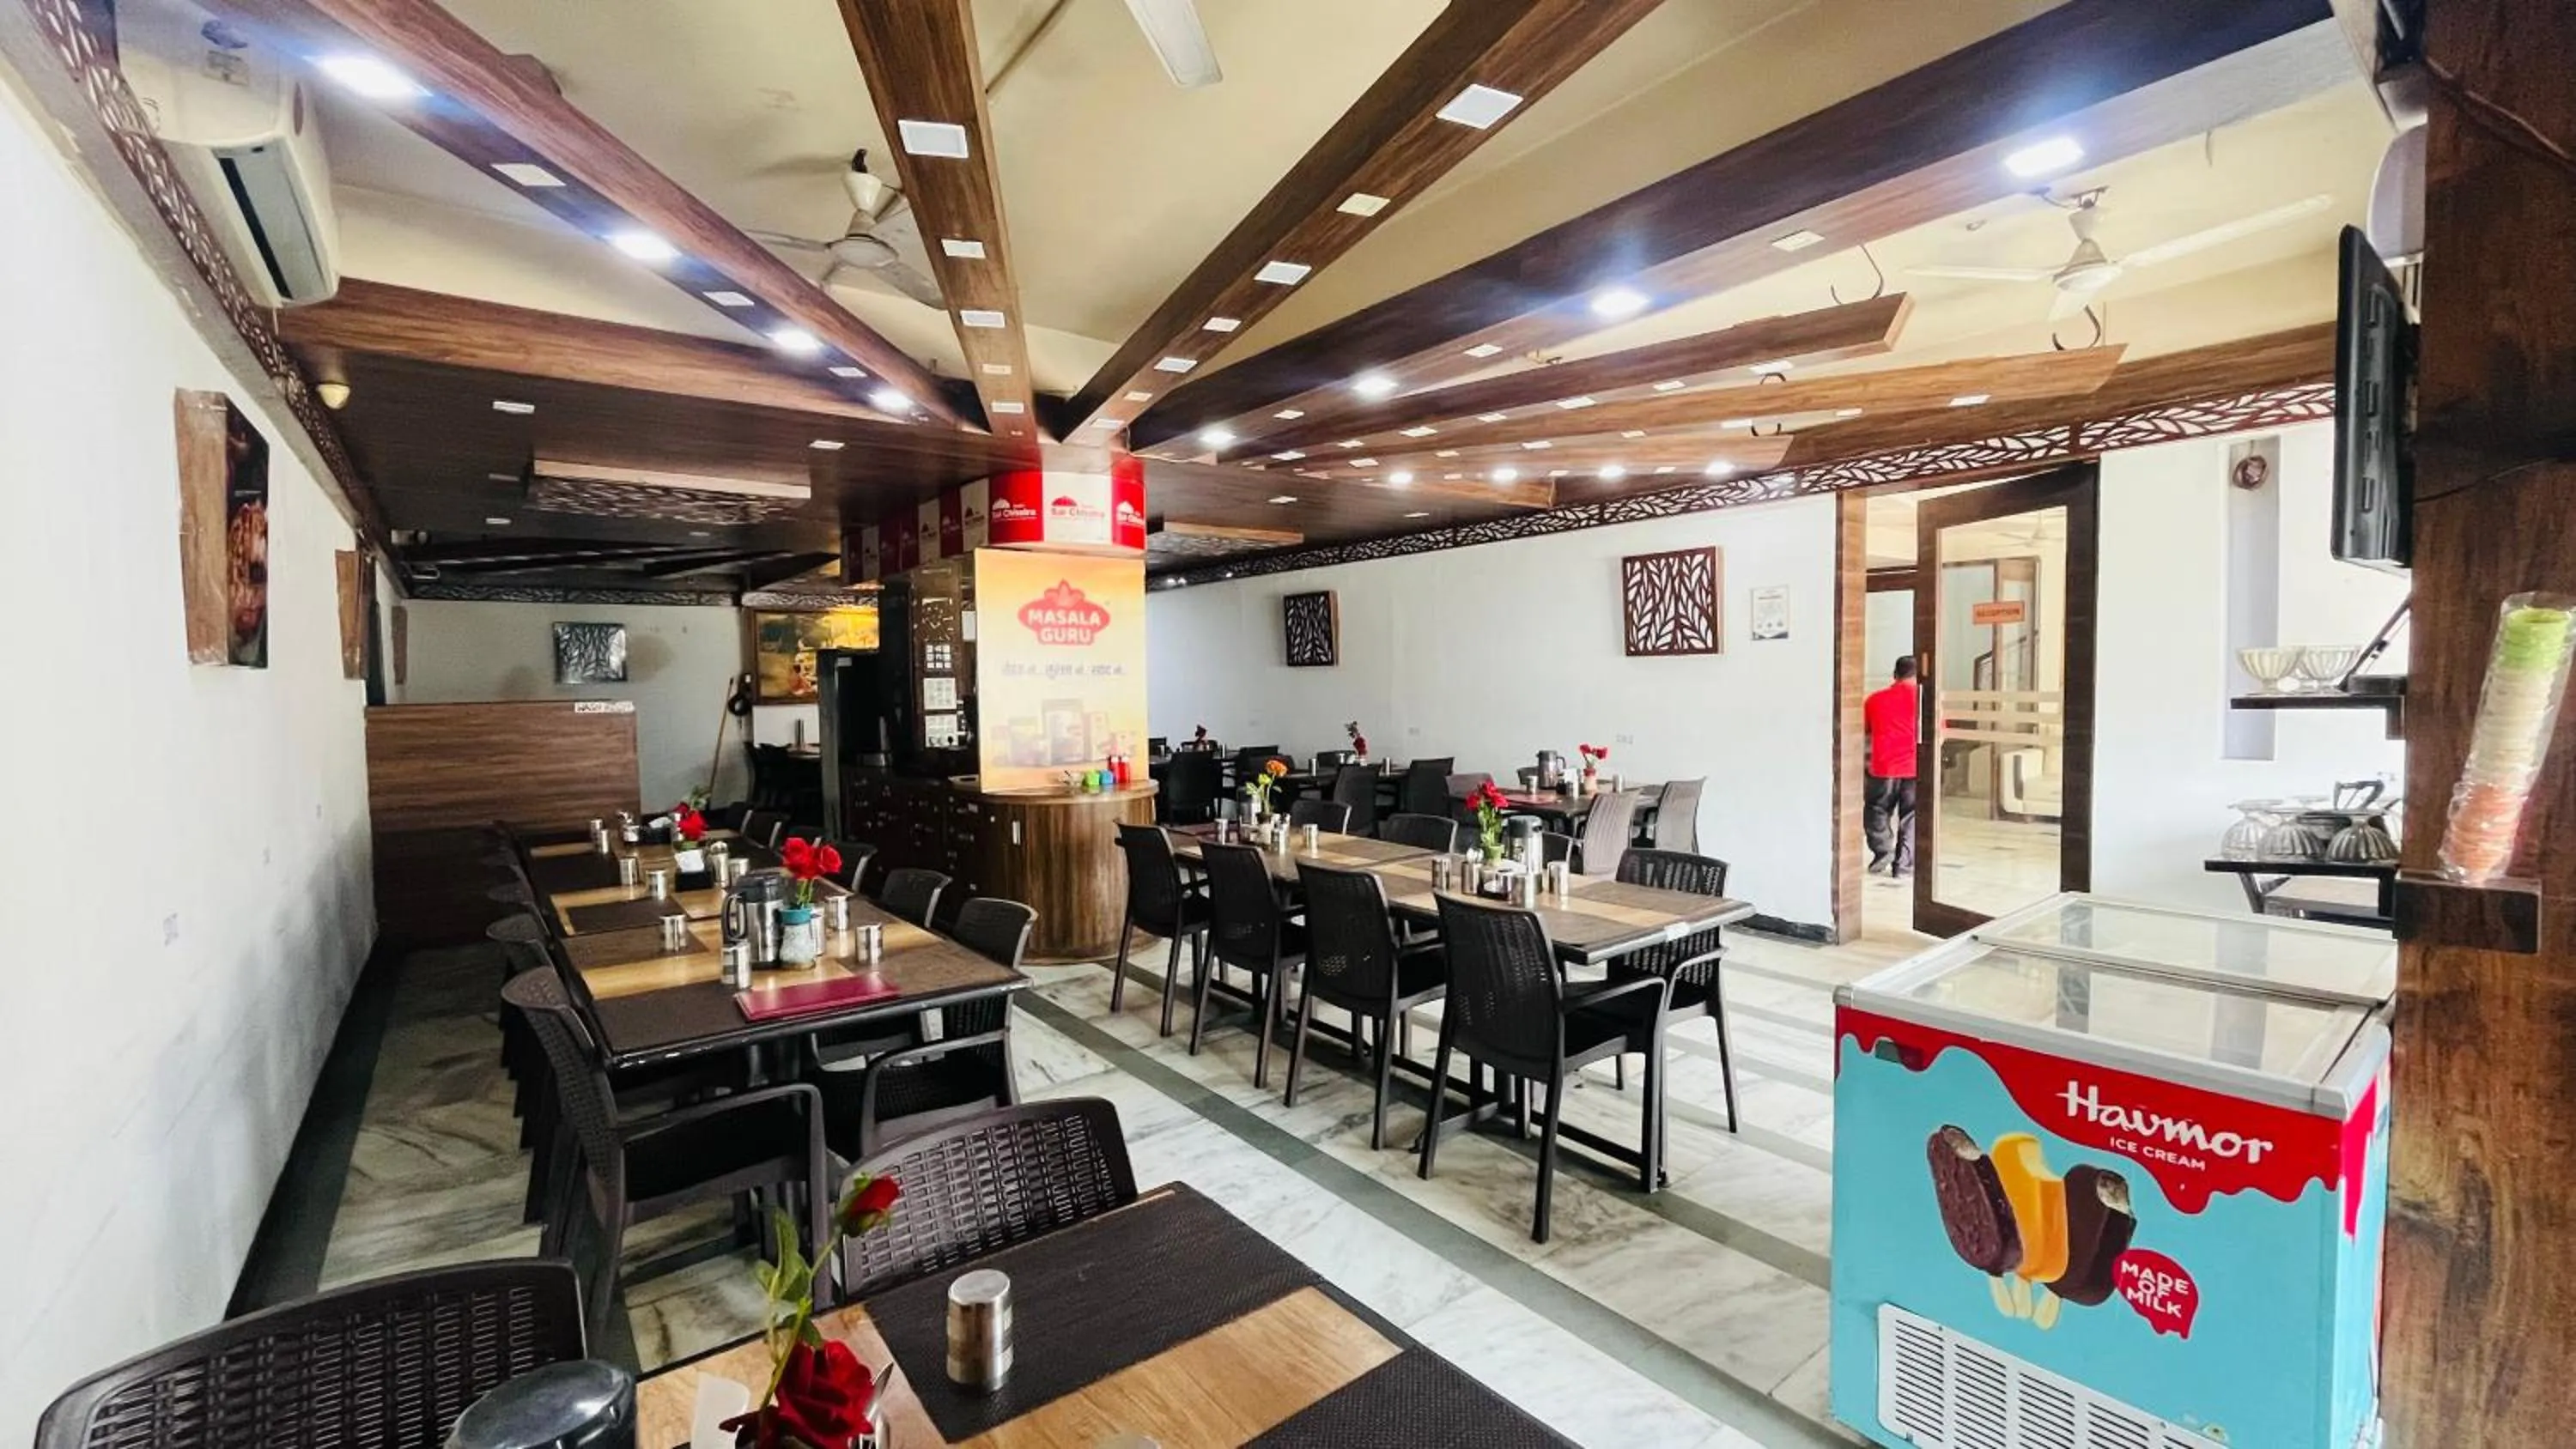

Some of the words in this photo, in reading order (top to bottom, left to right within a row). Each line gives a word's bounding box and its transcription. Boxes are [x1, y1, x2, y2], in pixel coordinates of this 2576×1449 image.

[1028, 609, 1101, 625] MASALA
[1040, 627, 1092, 642] GURU
[2056, 1080, 2274, 1164] Havmor
[2110, 1136, 2138, 1153] ICE
[2142, 1145, 2206, 1172] CREAM
[2121, 1259, 2190, 1295] MADE
[2137, 1279, 2172, 1298] OF
[2127, 1286, 2182, 1319] MILK
